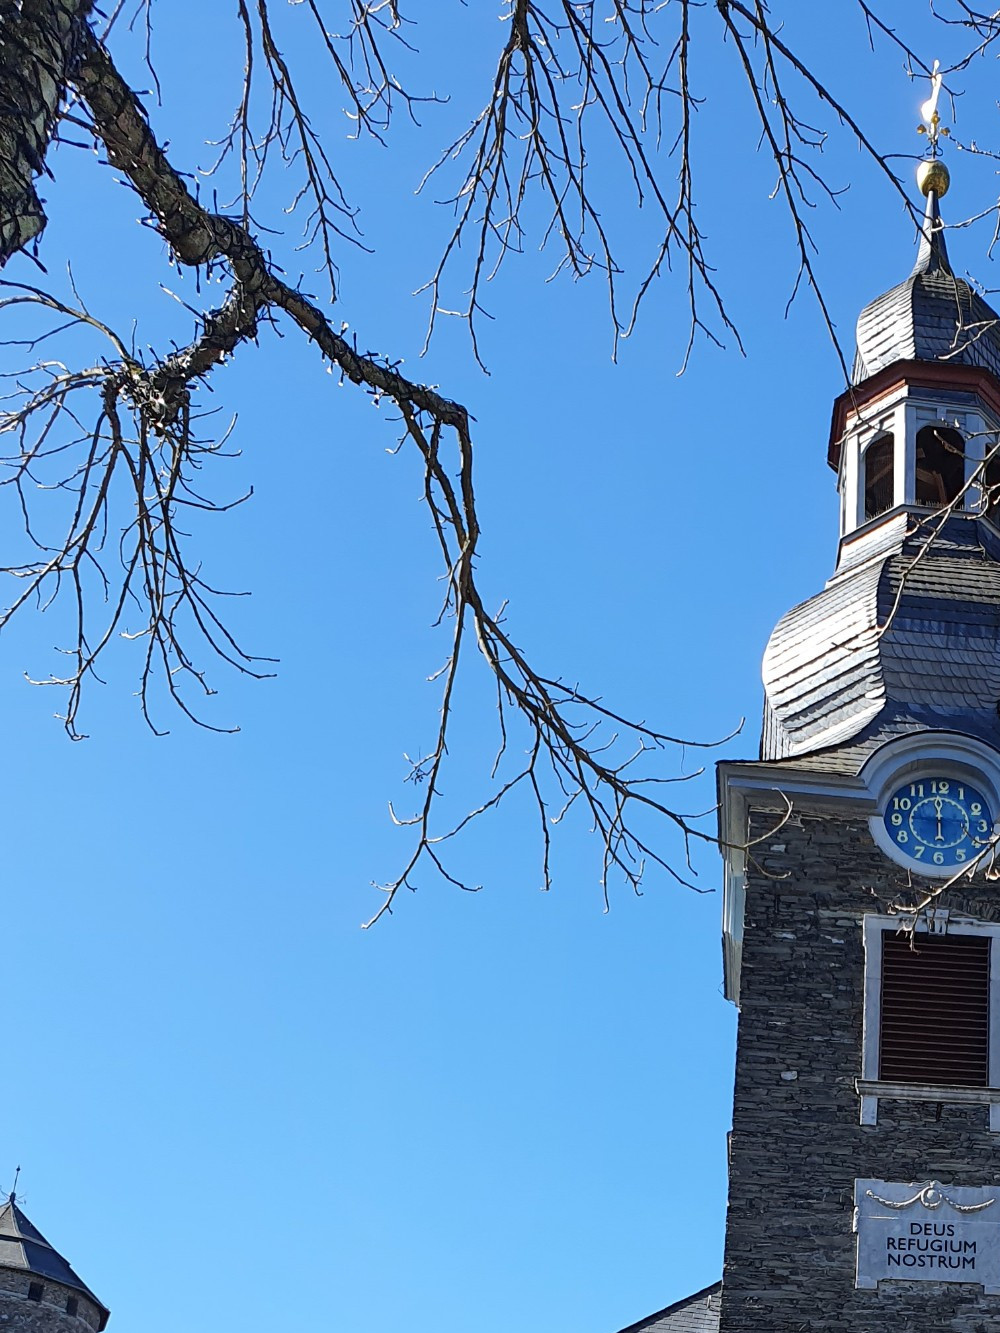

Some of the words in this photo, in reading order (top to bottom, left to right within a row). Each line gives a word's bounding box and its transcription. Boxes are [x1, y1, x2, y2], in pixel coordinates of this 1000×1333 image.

[910, 784, 924, 798] 11
[930, 780, 949, 794] 12
[958, 787, 965, 800] 1
[892, 797, 911, 811] 10
[970, 802, 982, 816] 2
[891, 813, 902, 826] 9
[977, 819, 988, 833] 3
[896, 830, 908, 843] 8
[971, 836, 982, 849] 4
[914, 846, 925, 859] 7
[933, 852, 944, 864] 6
[955, 849, 966, 862] 5
[910, 1222, 955, 1237] DEUS
[887, 1237, 977, 1254] REFUGIUM
[887, 1253, 975, 1269] NOSTRUM
